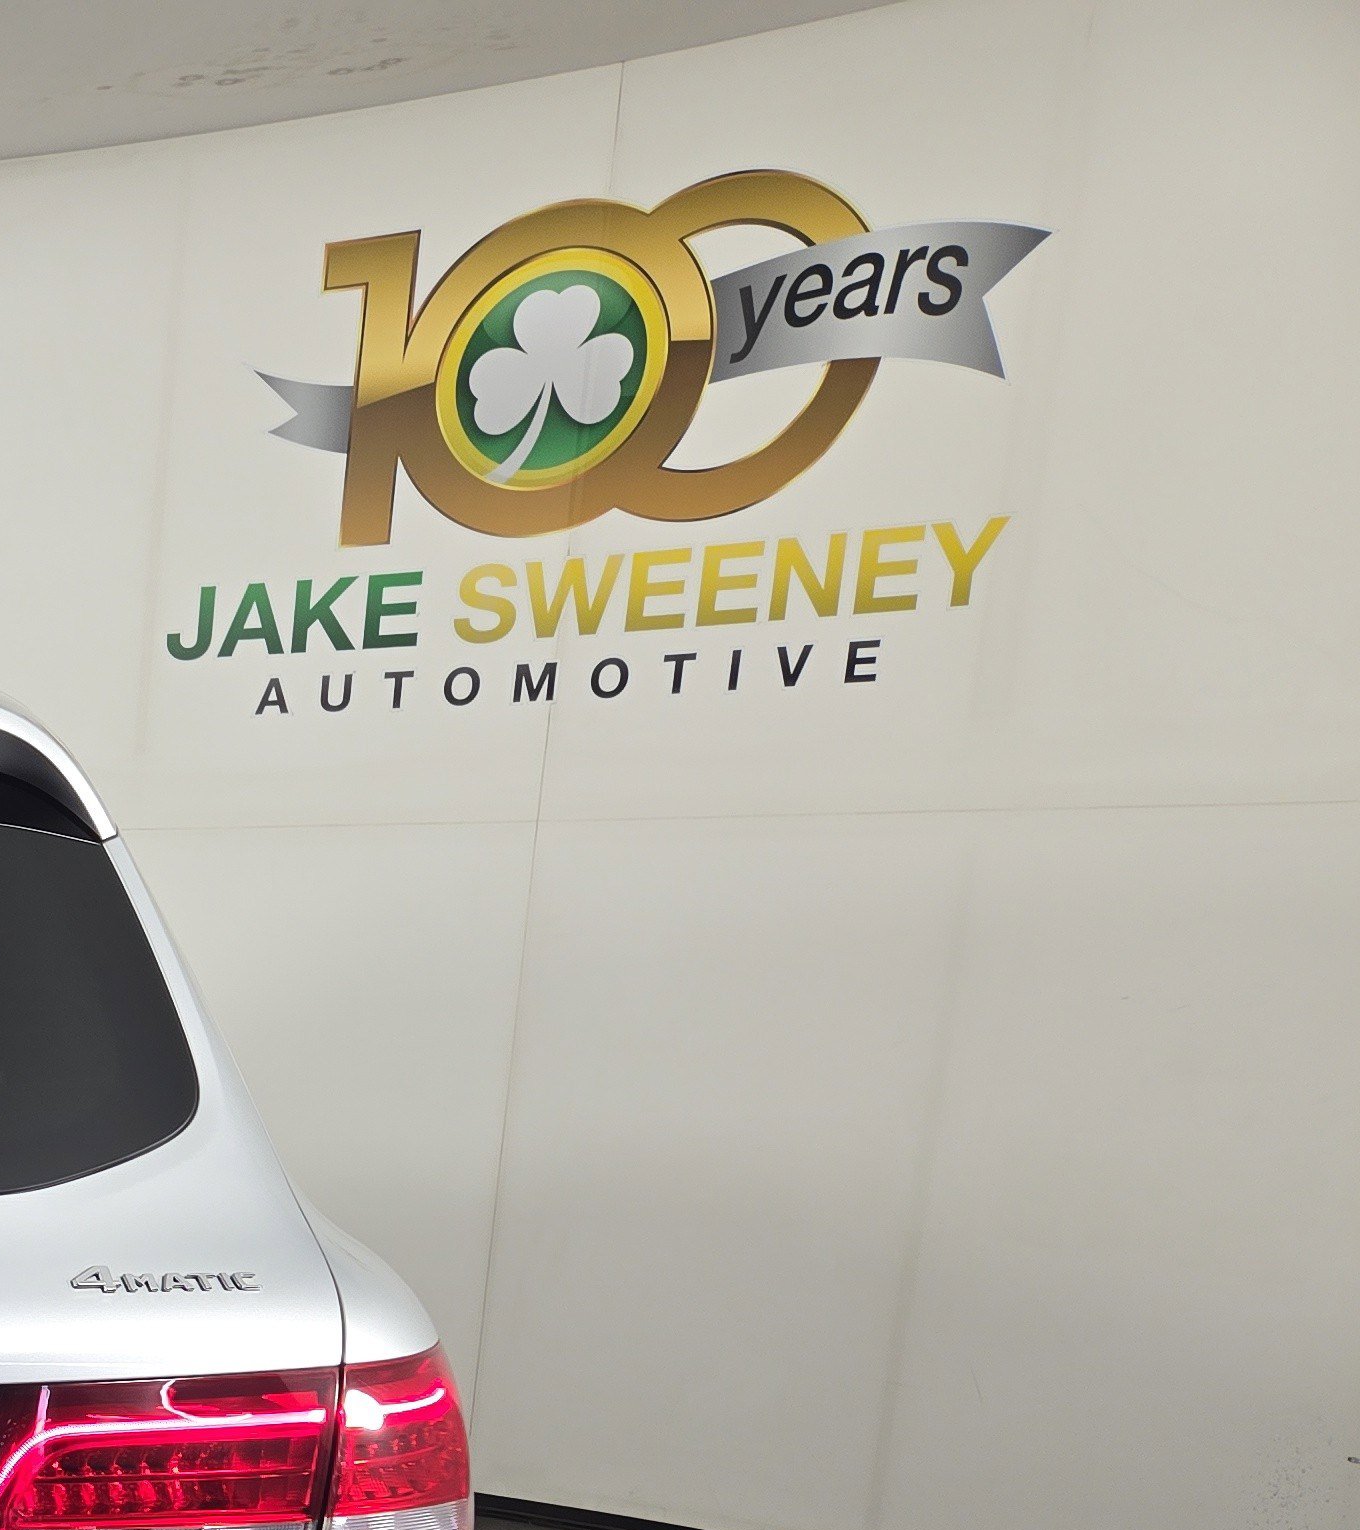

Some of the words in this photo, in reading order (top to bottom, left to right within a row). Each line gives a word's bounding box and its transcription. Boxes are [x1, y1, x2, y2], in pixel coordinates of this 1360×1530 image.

[322, 169, 881, 547] 100
[728, 245, 969, 364] years
[167, 571, 423, 661] JAKE
[452, 516, 1011, 644] SWEENEY
[254, 640, 882, 715] AUTOMOTIVE
[70, 1265, 261, 1293] 4MATIC
